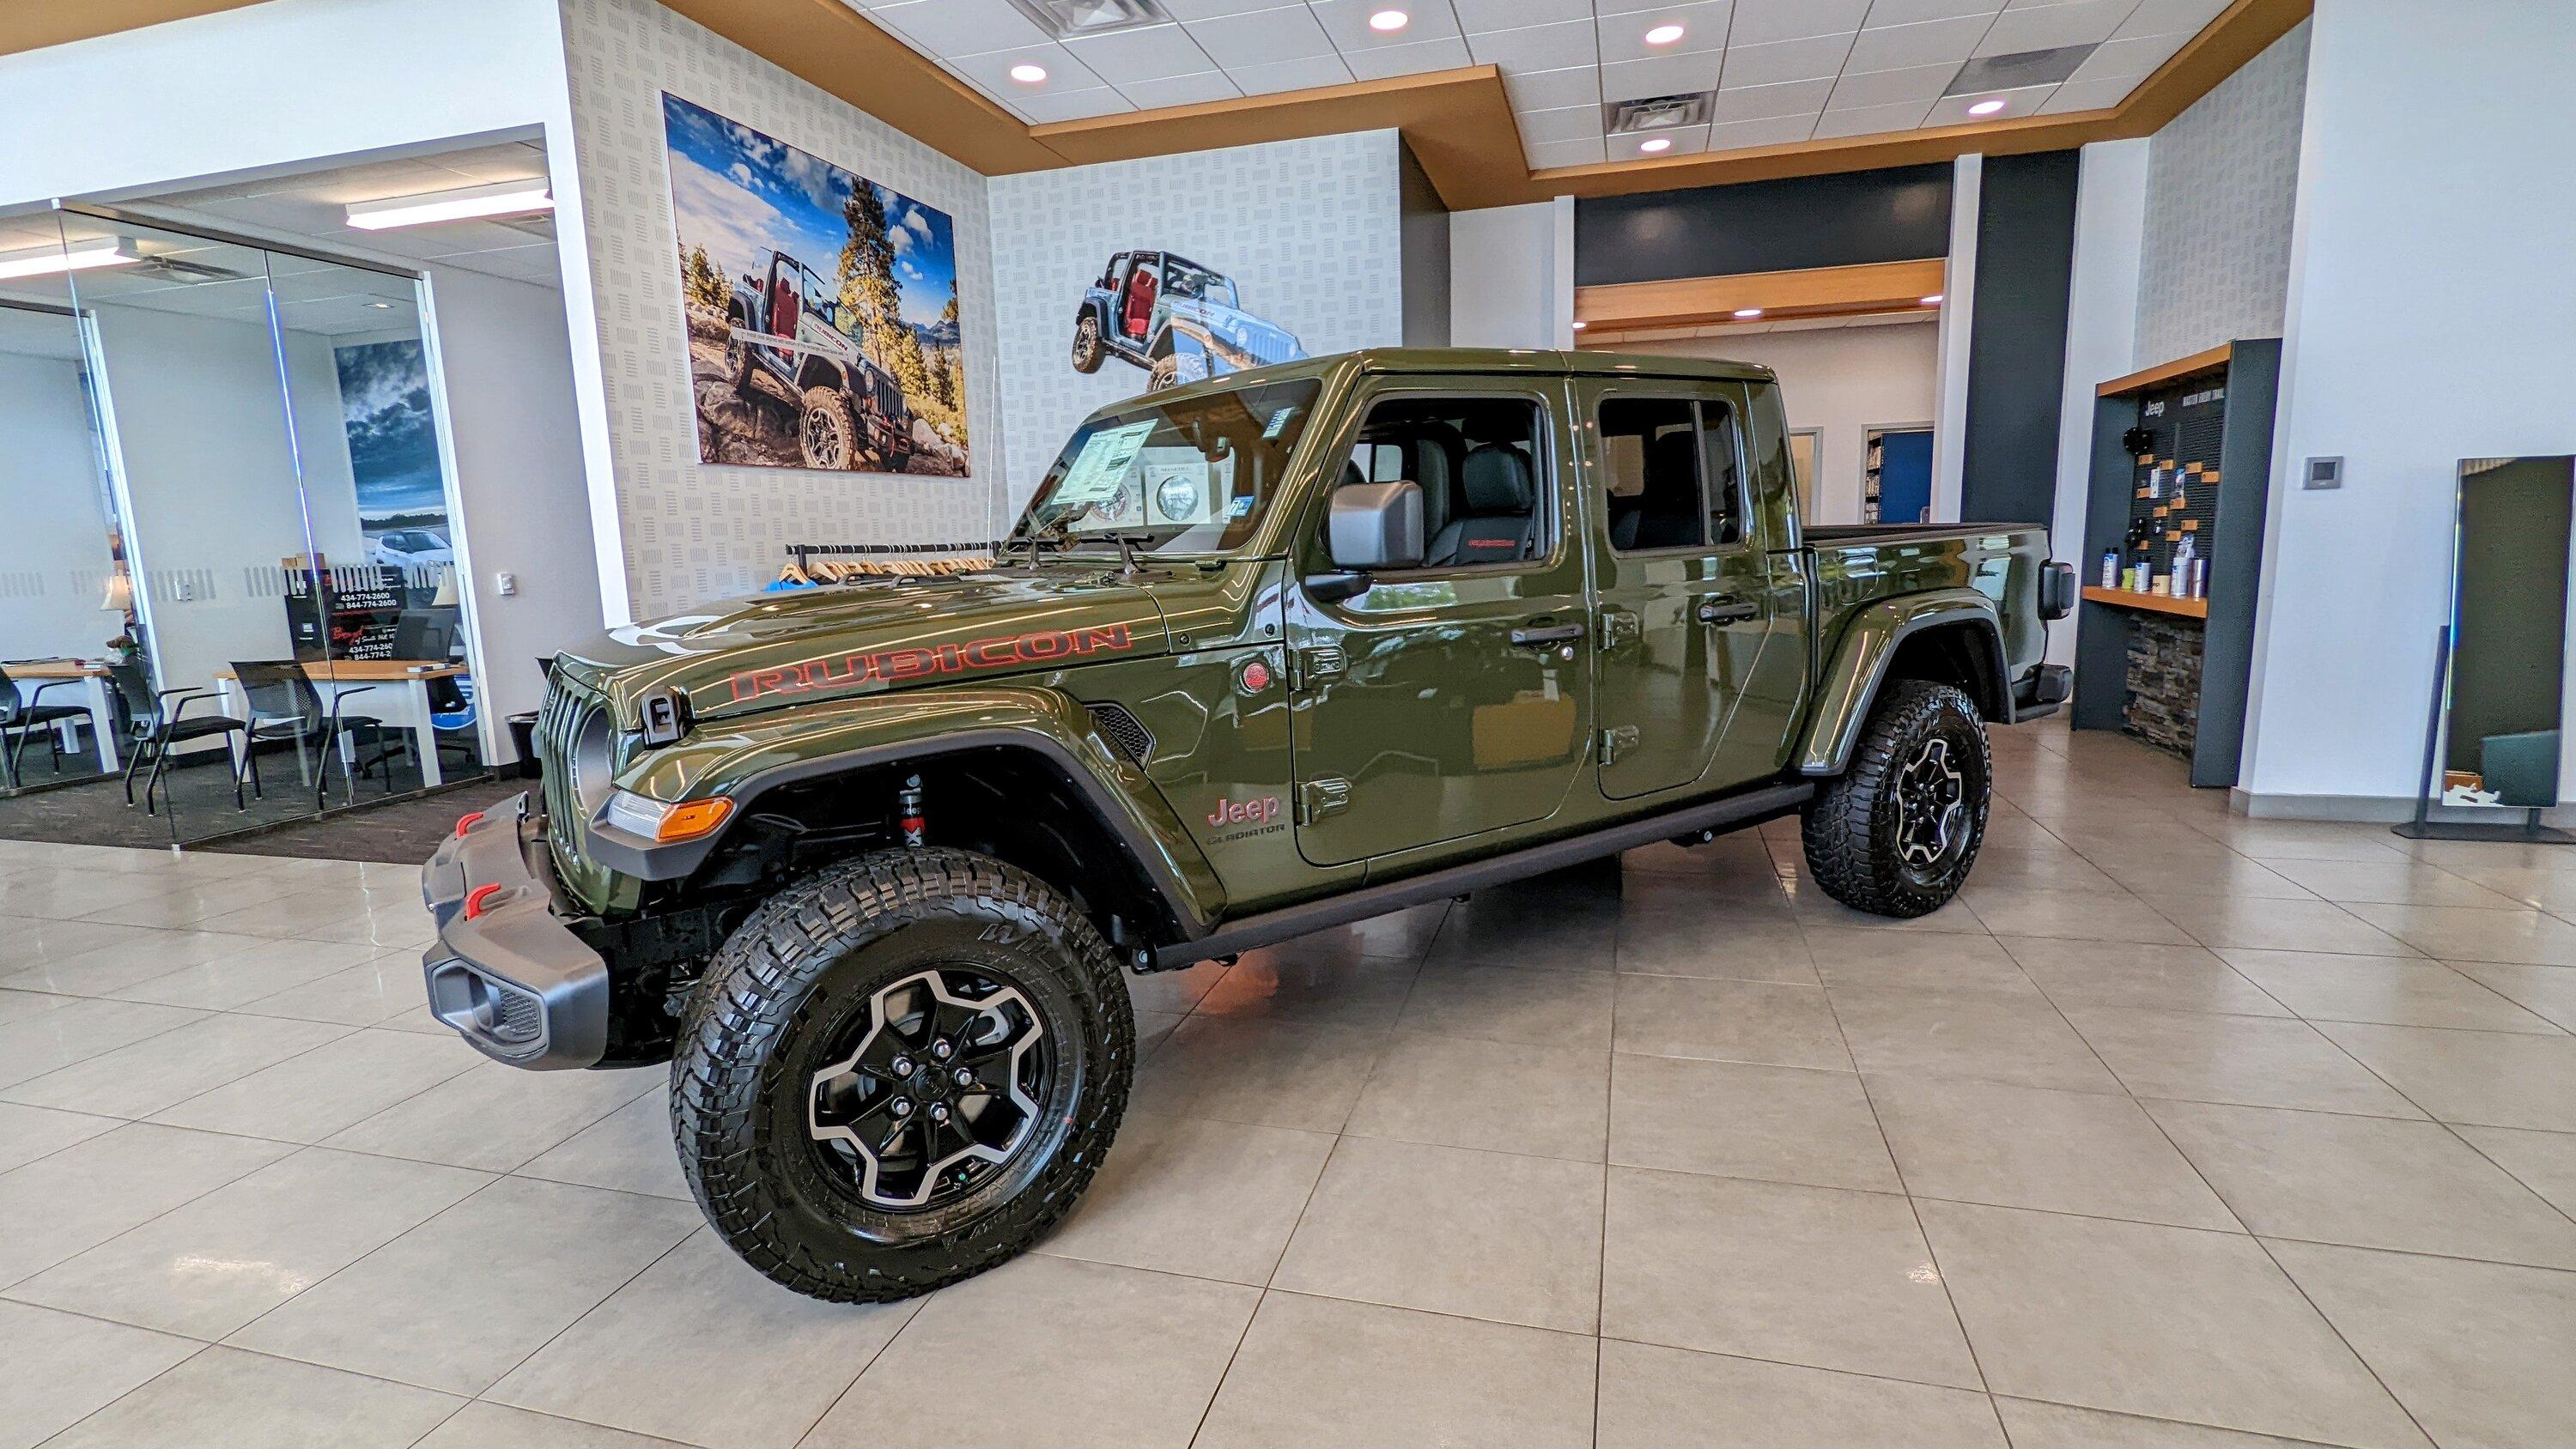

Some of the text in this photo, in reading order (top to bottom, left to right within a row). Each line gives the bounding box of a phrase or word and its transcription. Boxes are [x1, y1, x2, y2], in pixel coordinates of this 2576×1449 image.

[815, 323, 848, 351] RUBICON
[2145, 400, 2165, 417] Jeep
[340, 592, 391, 602] 434-774-2600
[346, 599, 397, 609] 844-774-2600
[349, 643, 393, 655] 434-774-260
[354, 650, 392, 661] 844-774-2
[730, 623, 1133, 701] RUBICON
[1207, 797, 1281, 828] Jeep
[1206, 823, 1285, 846] GLADIATOR
